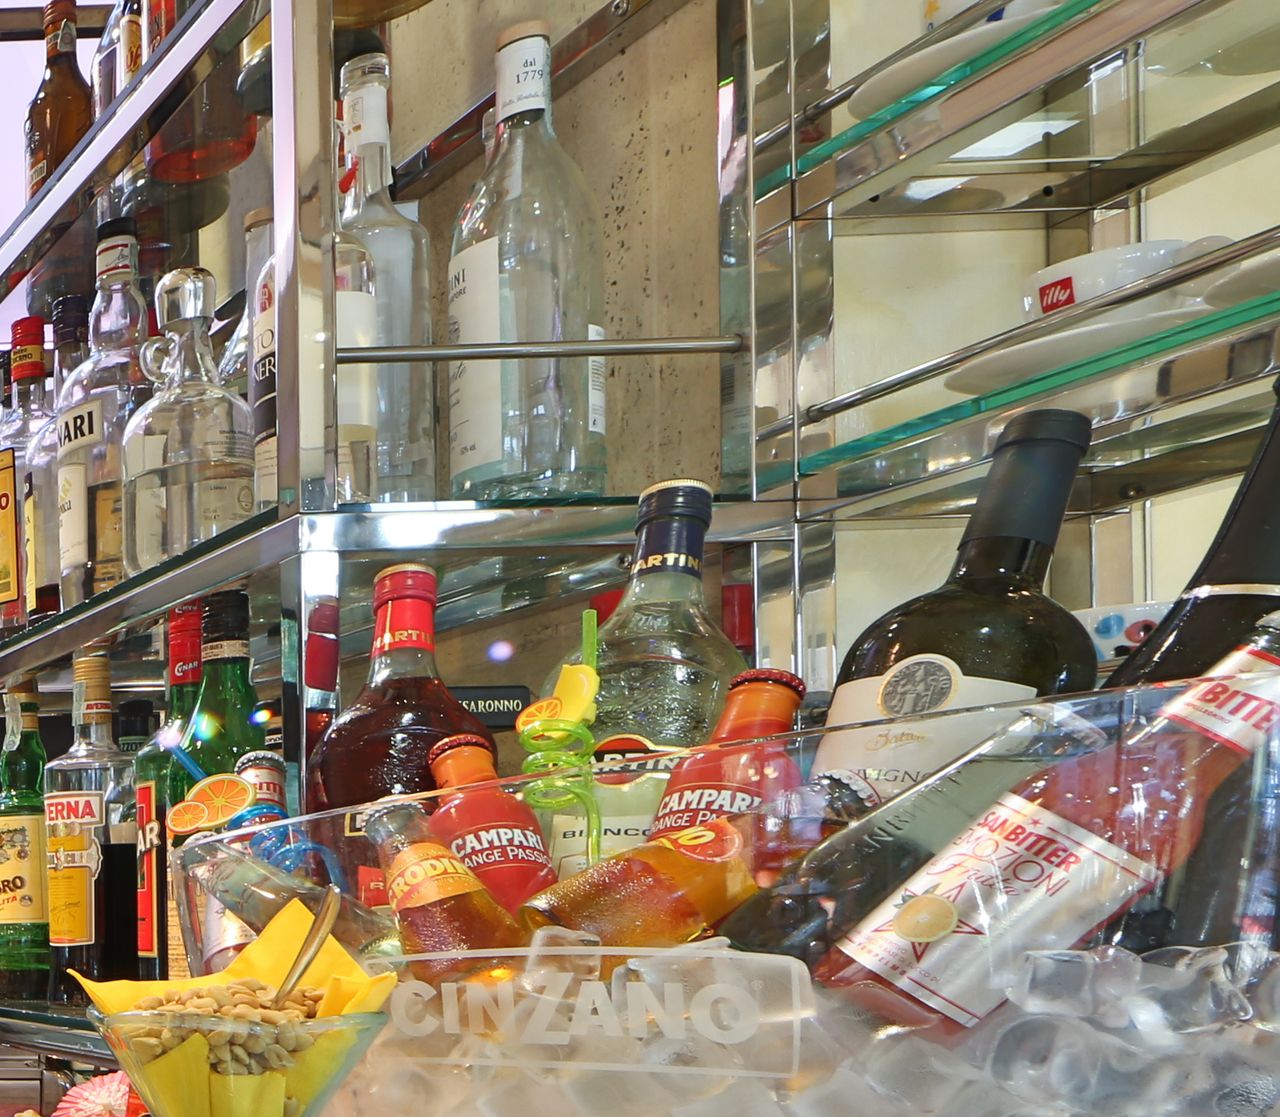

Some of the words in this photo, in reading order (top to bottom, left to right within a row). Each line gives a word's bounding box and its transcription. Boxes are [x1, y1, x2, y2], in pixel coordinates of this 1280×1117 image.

[523, 57, 536, 68] dal
[515, 67, 544, 84] 1779
[1042, 285, 1071, 306] illy
[174, 661, 199, 677] CYNAR
[977, 811, 1082, 873] SANBITTER
[390, 972, 763, 1046] CINZANO
